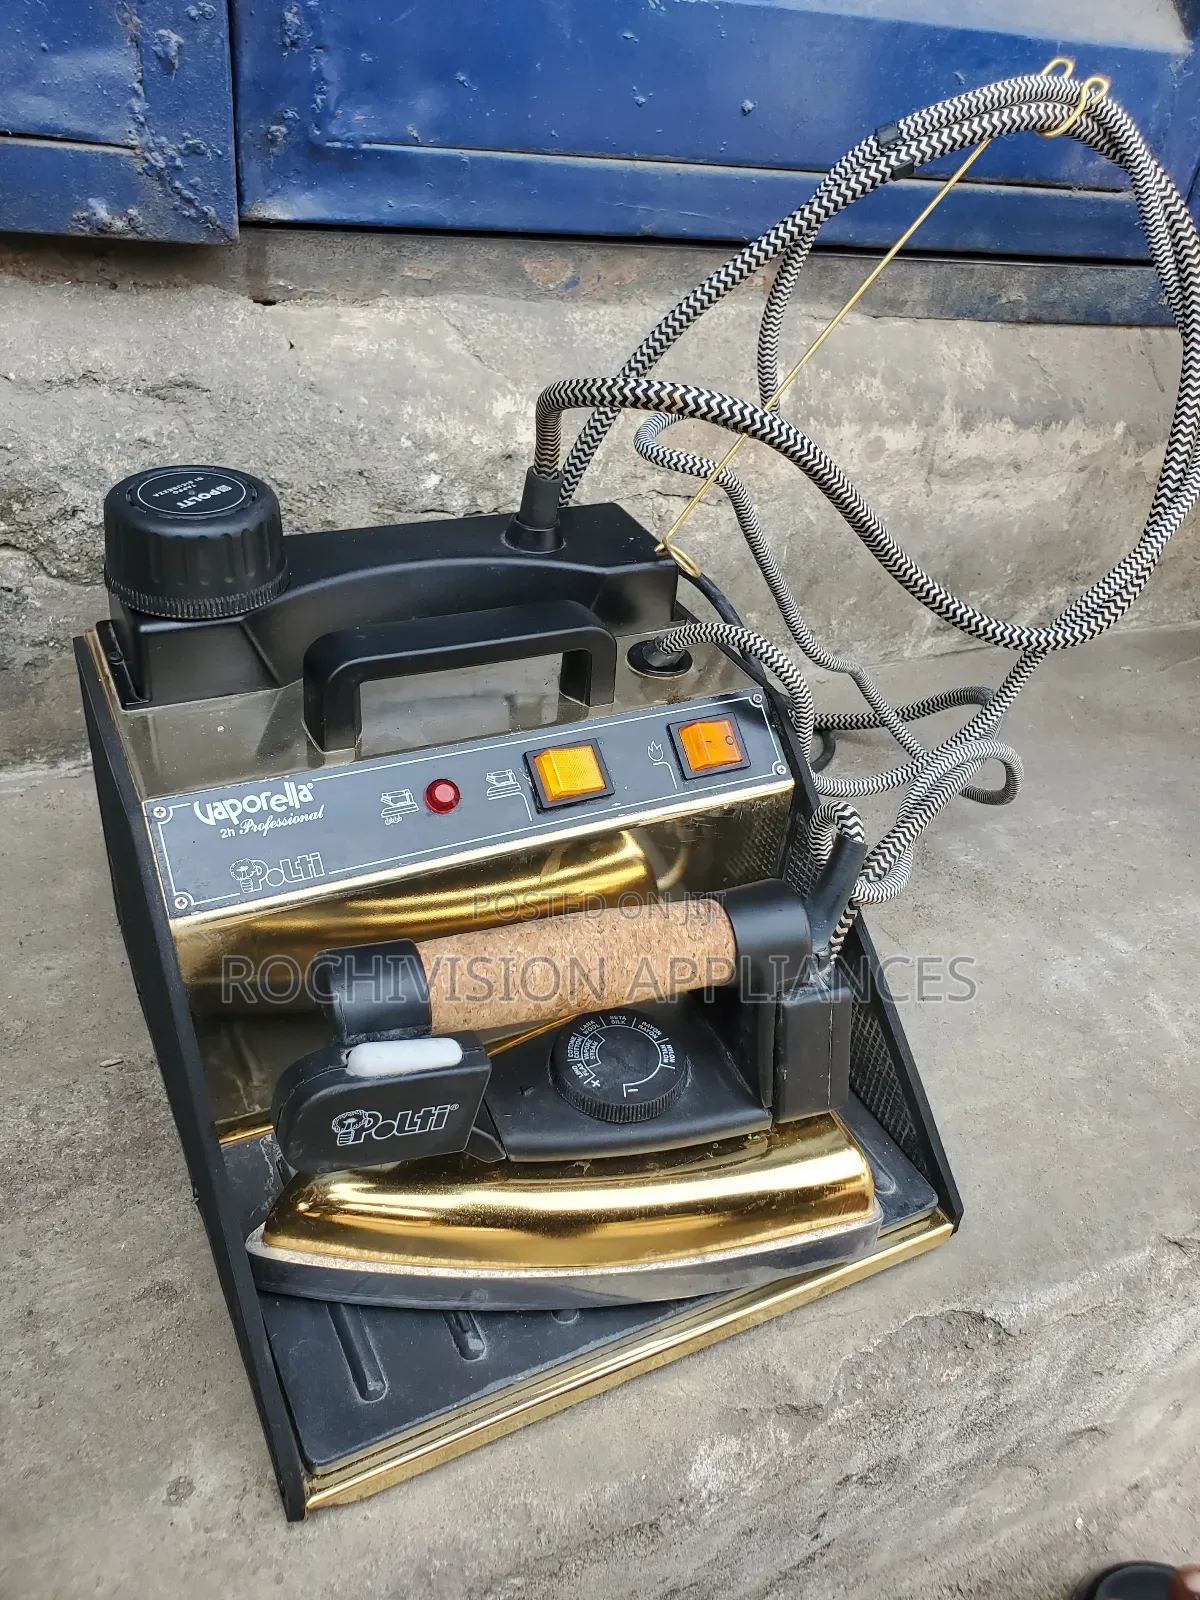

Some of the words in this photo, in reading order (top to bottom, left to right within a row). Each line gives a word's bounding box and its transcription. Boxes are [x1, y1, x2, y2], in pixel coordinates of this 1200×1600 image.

[177, 489, 222, 508] POLTI
[219, 827, 236, 839] 2h
[238, 804, 325, 837] Professional
[583, 1024, 601, 1035] WOOL
[637, 1024, 658, 1040] RAYON
[642, 1021, 662, 1036] RAYON
[567, 1036, 577, 1058] COTONE
[573, 1037, 584, 1059] COTTON
[584, 1039, 593, 1060] VAPORE
[590, 1041, 599, 1060] STEAM
